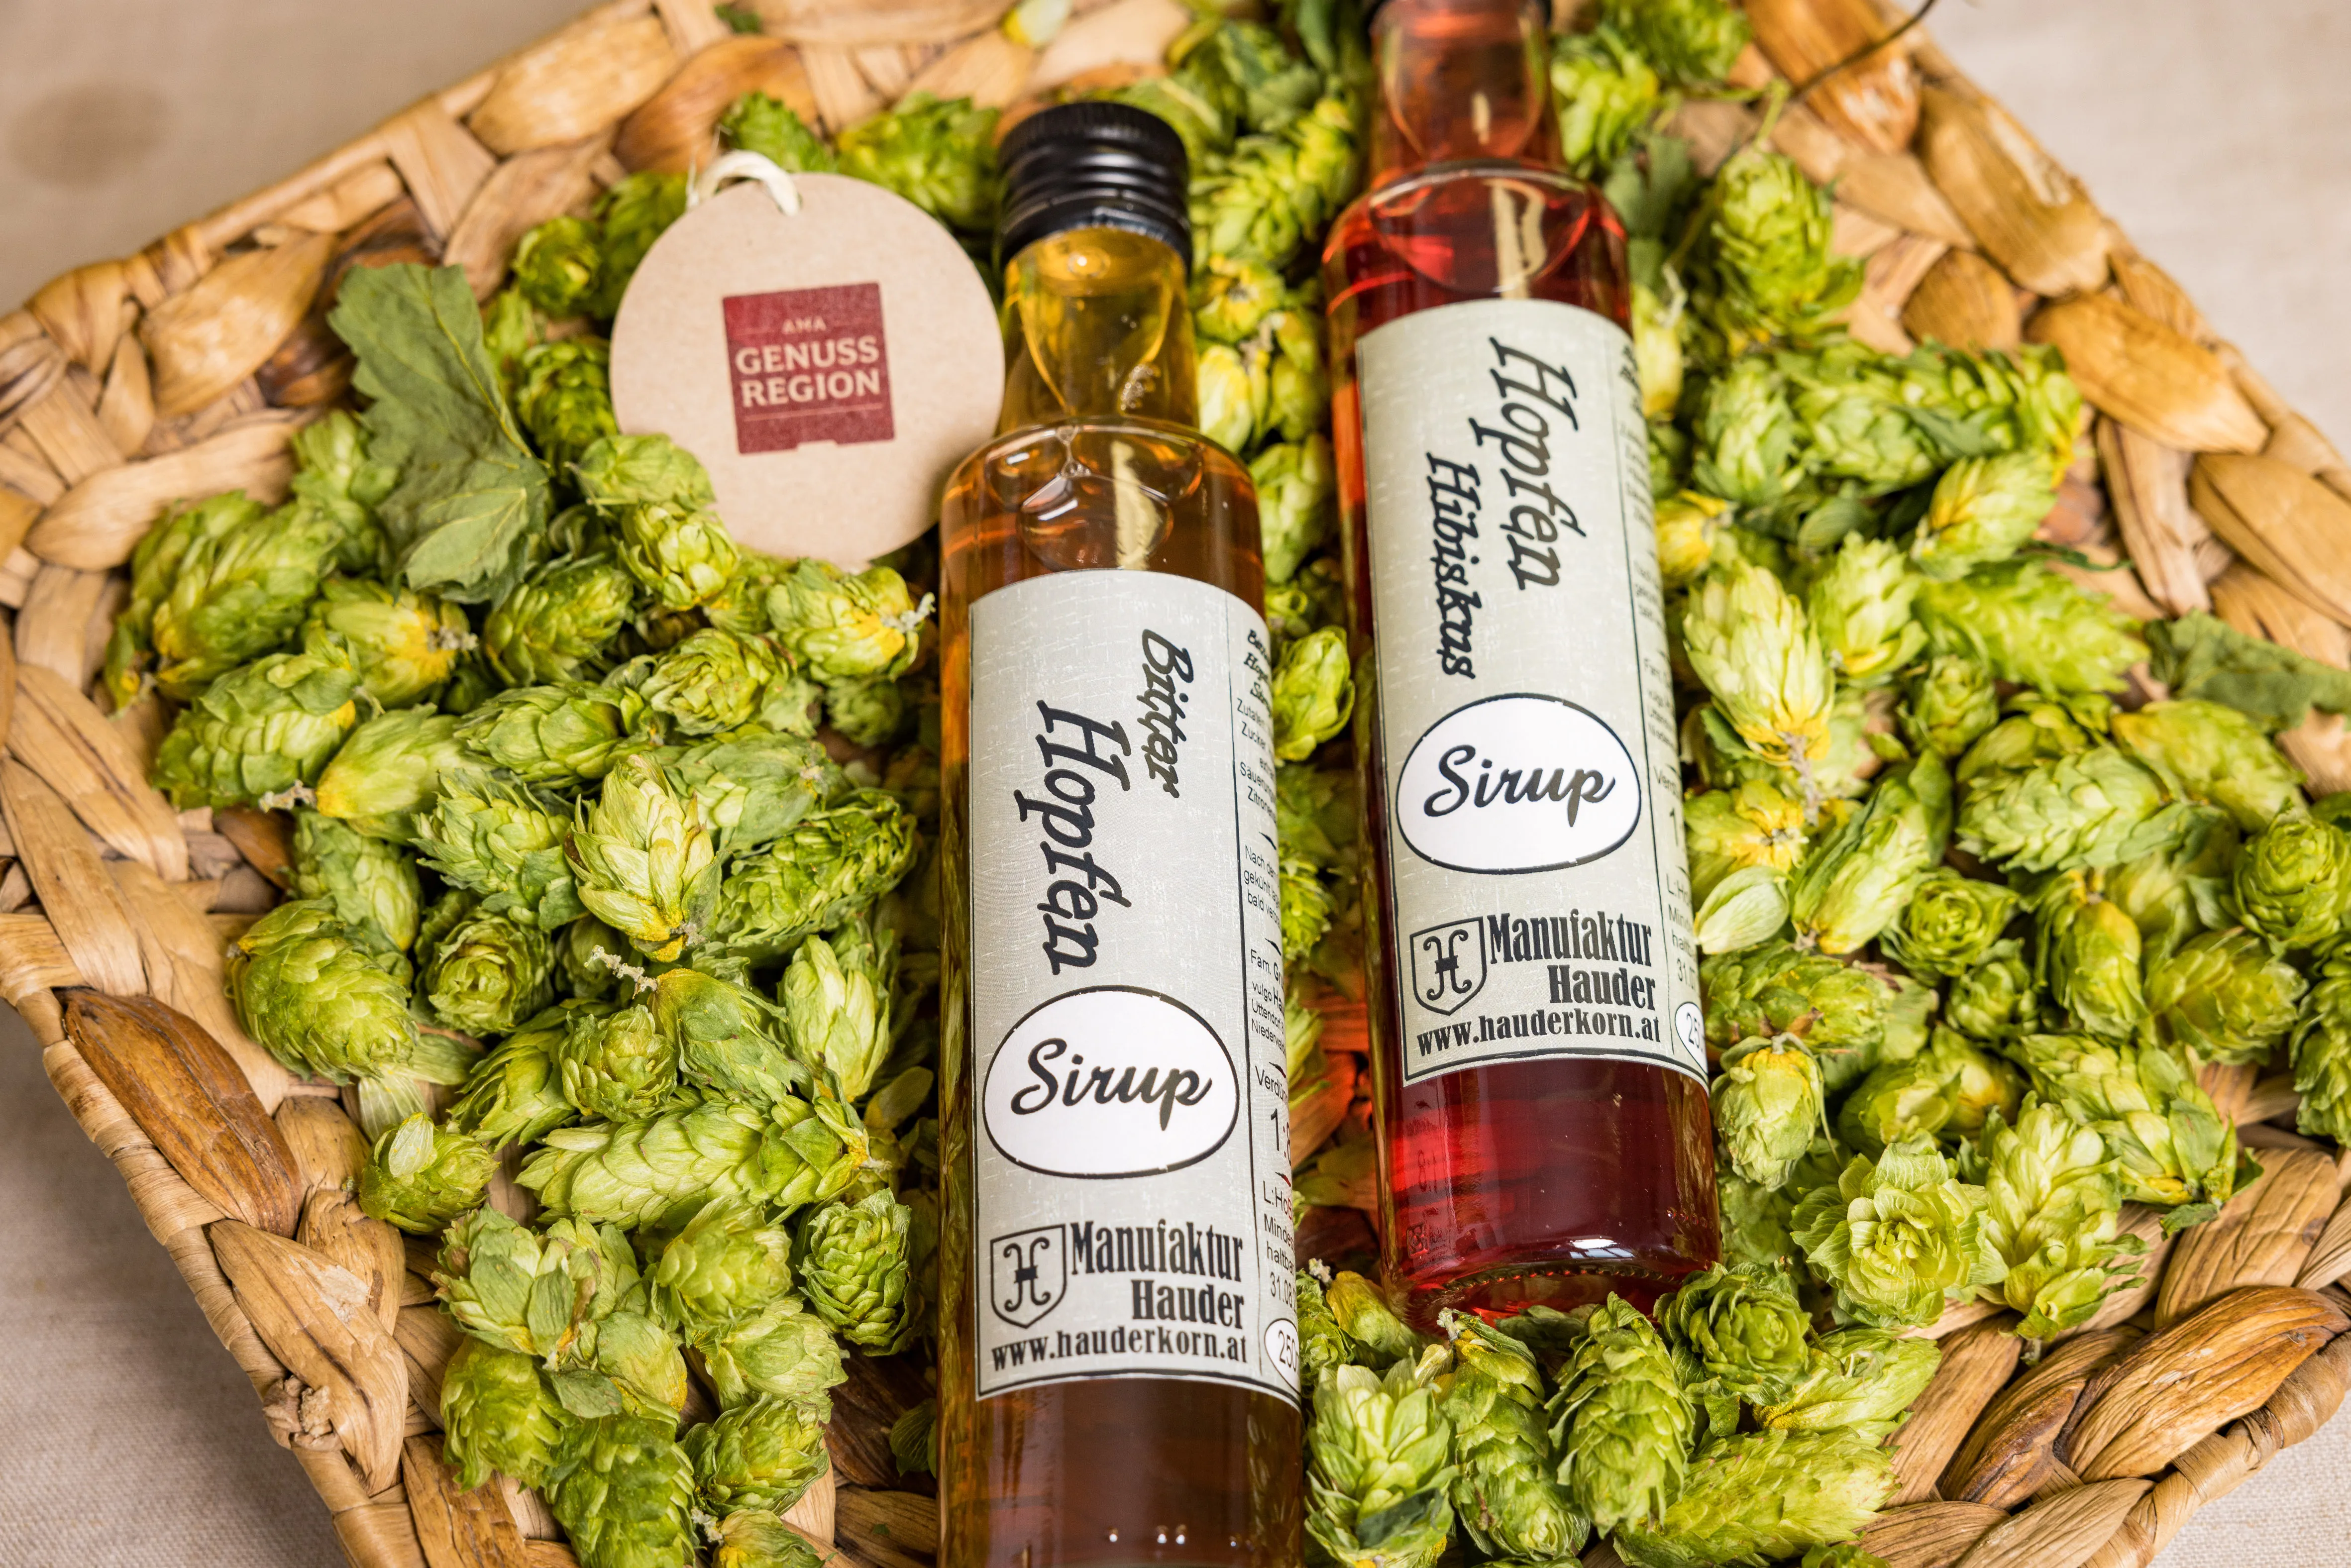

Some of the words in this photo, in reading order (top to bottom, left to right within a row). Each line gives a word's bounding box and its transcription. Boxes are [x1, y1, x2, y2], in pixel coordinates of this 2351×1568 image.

[782, 315, 827, 334] AMA
[735, 335, 880, 375] GENUSS
[741, 368, 881, 408] REGION
[1469, 336, 1586, 591] Hopfen
[1426, 451, 1482, 679] Hibiskus
[1142, 628, 1194, 799] Bitter
[1423, 744, 1615, 828] Sirup
[1013, 700, 1132, 975] Hopfen
[1245, 844, 1265, 871] Nach
[1247, 888, 1265, 912] bald
[1250, 948, 1272, 975] Fam.
[1487, 908, 1652, 967] Manufaktur
[1252, 981, 1272, 1002] vulgo
[1547, 964, 1656, 1011] Hauder
[1416, 1008, 1661, 1057] www.hauderkorn.at
[1010, 1038, 1213, 1132] Sirup
[1070, 1219, 1243, 1282] Manufaktur
[1130, 1279, 1244, 1330] Hauder
[991, 1325, 1248, 1372] www.hauderkorn.at
